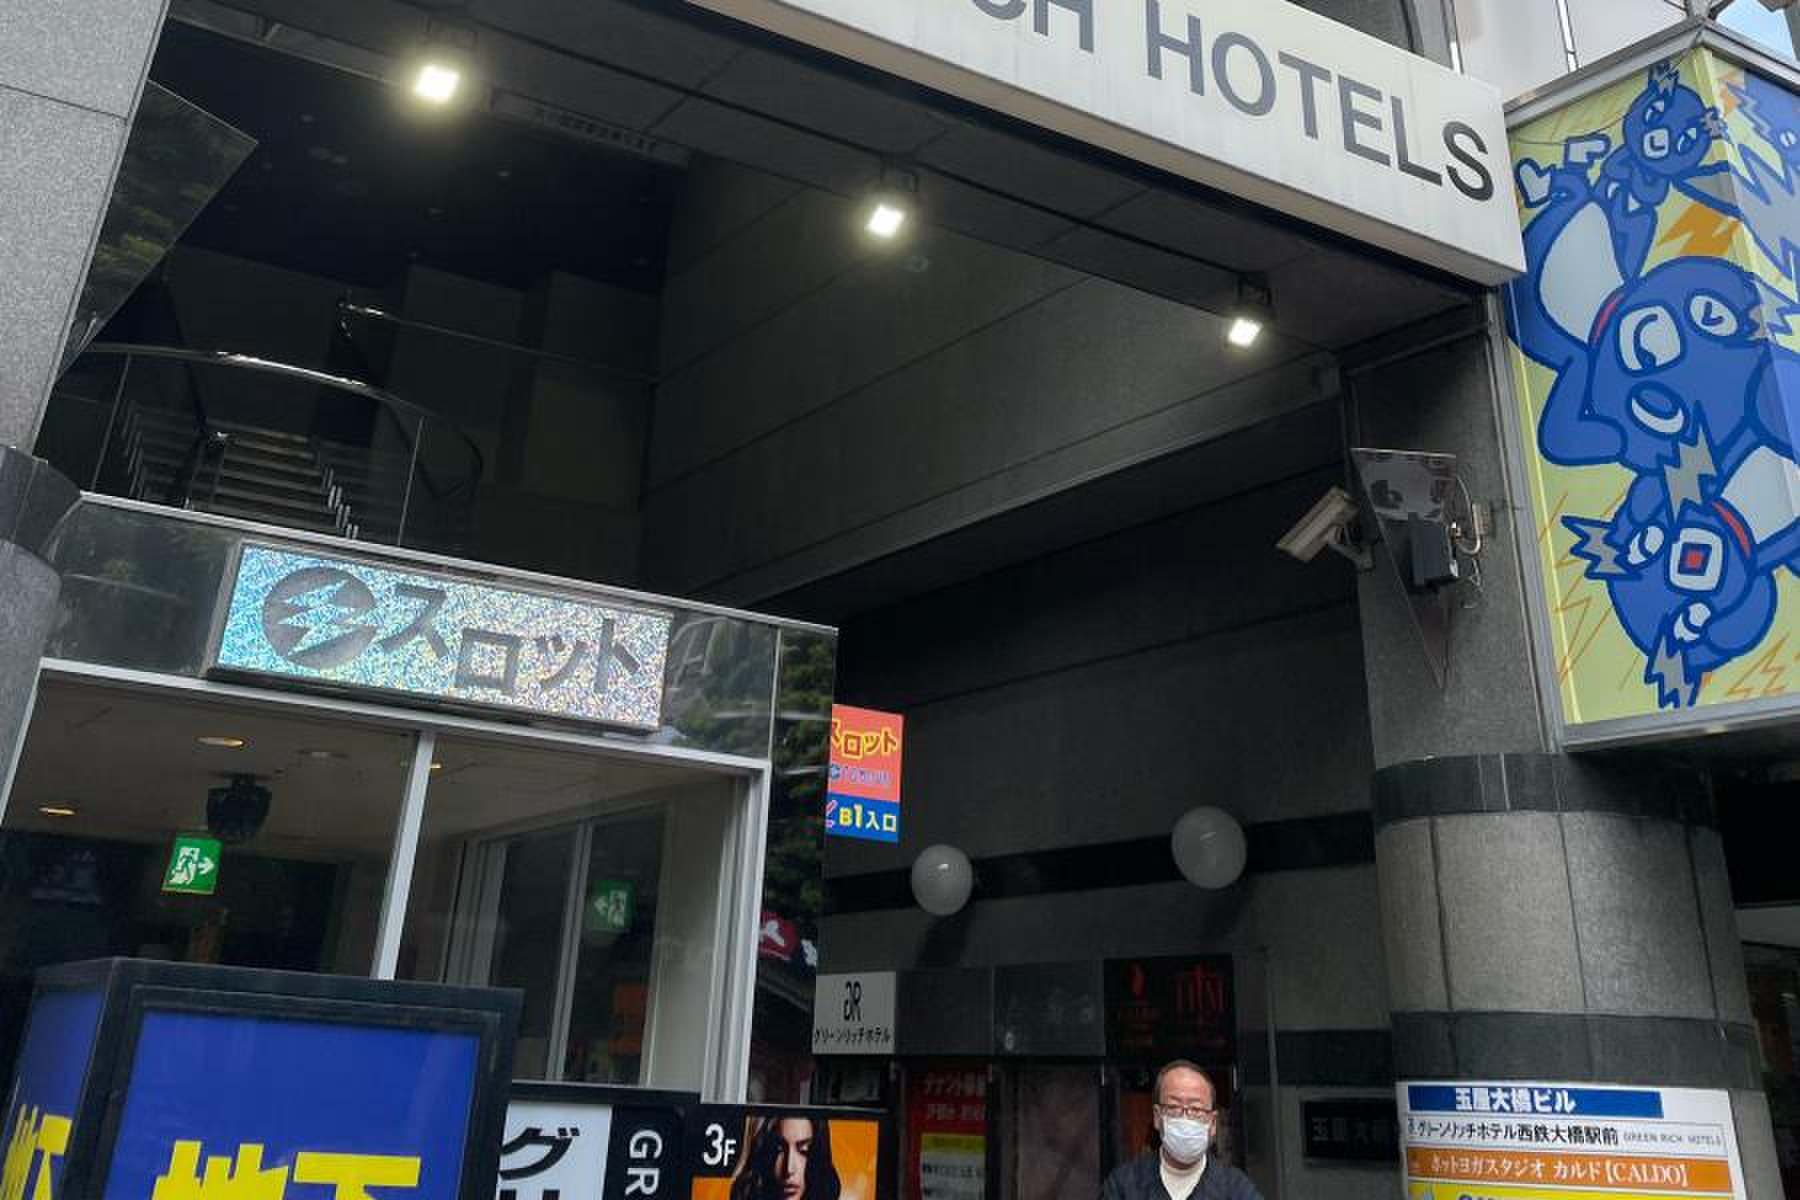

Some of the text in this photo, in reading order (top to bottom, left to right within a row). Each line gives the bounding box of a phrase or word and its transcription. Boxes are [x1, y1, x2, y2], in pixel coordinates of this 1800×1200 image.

[378, 580, 642, 696] スロット
[839, 793, 897, 833] B1入口
[703, 1122, 737, 1167] 3F
